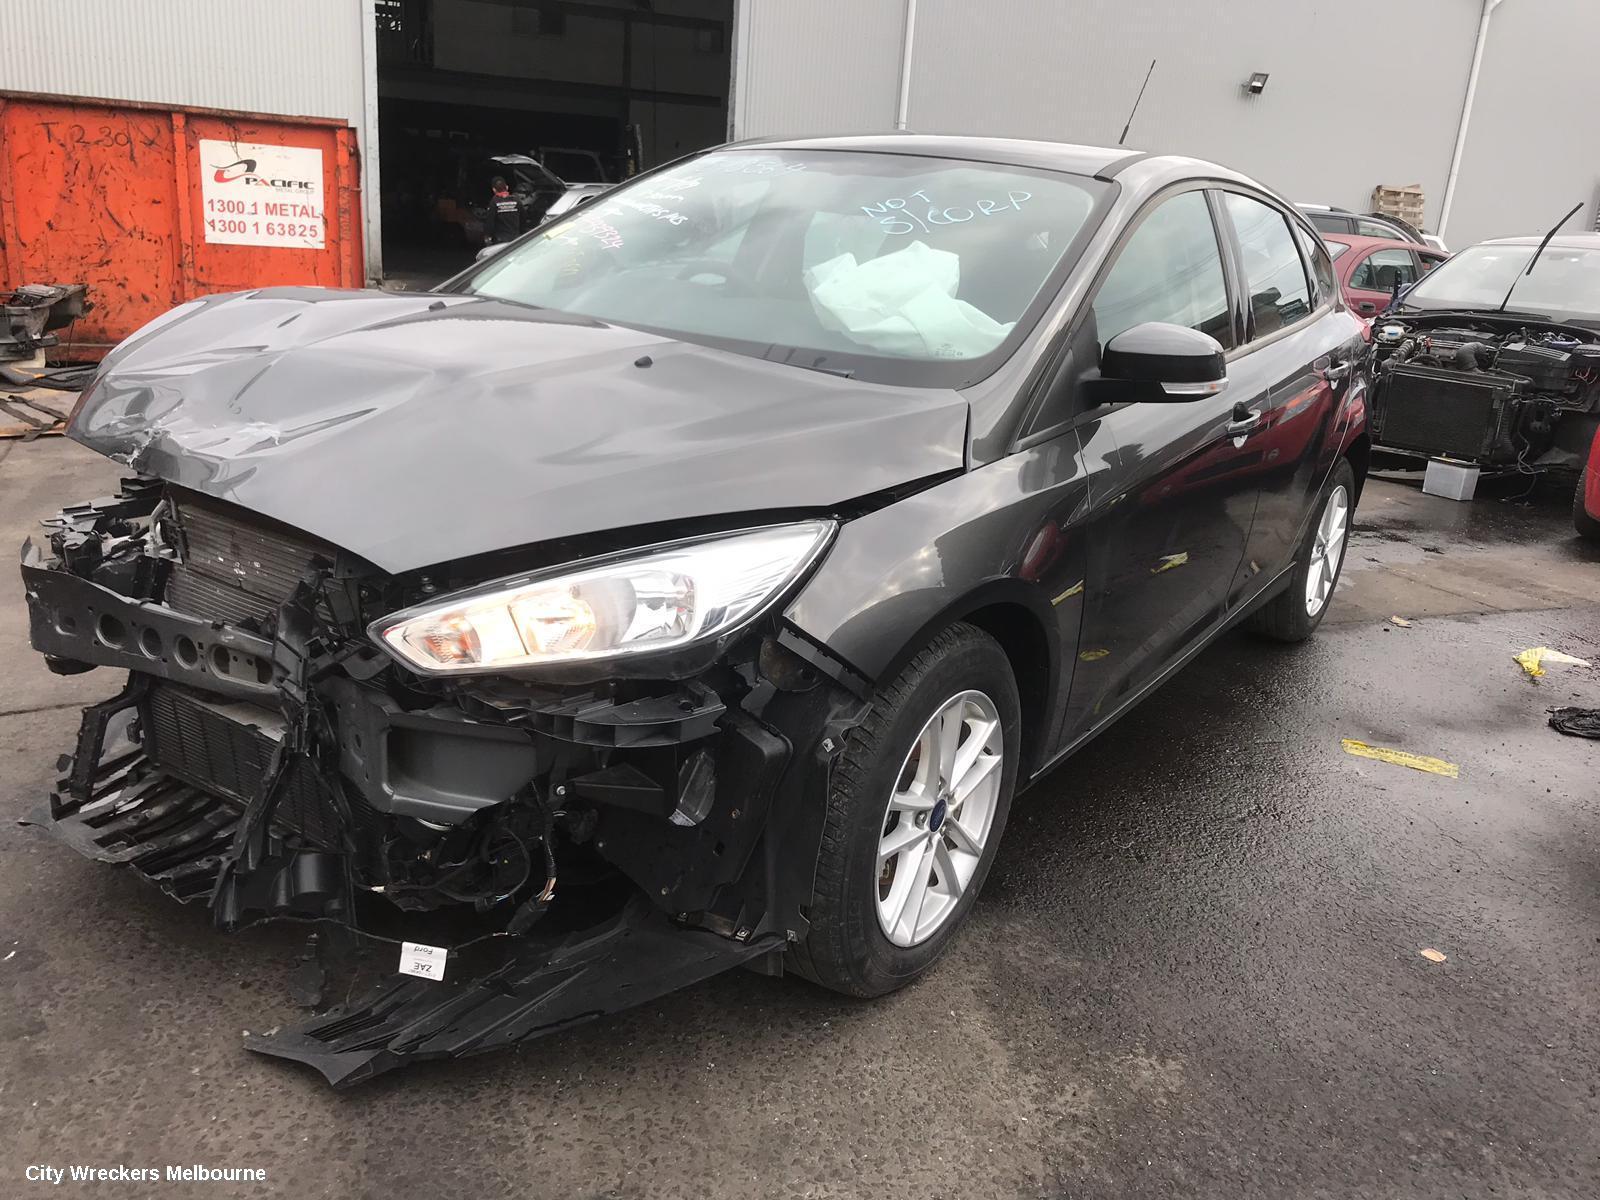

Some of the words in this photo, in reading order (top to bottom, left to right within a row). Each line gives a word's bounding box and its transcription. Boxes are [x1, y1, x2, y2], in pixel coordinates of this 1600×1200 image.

[245, 177, 315, 190] PACIFIC
[208, 198, 245, 214] 1300
[250, 201, 258, 215] 1
[265, 203, 321, 219] METAL
[860, 189, 931, 219] NOT
[208, 218, 247, 234] 1300
[252, 221, 260, 235] 1
[266, 222, 318, 238] 63825
[414, 946, 433, 955] Ford
[414, 962, 433, 972] ZAE
